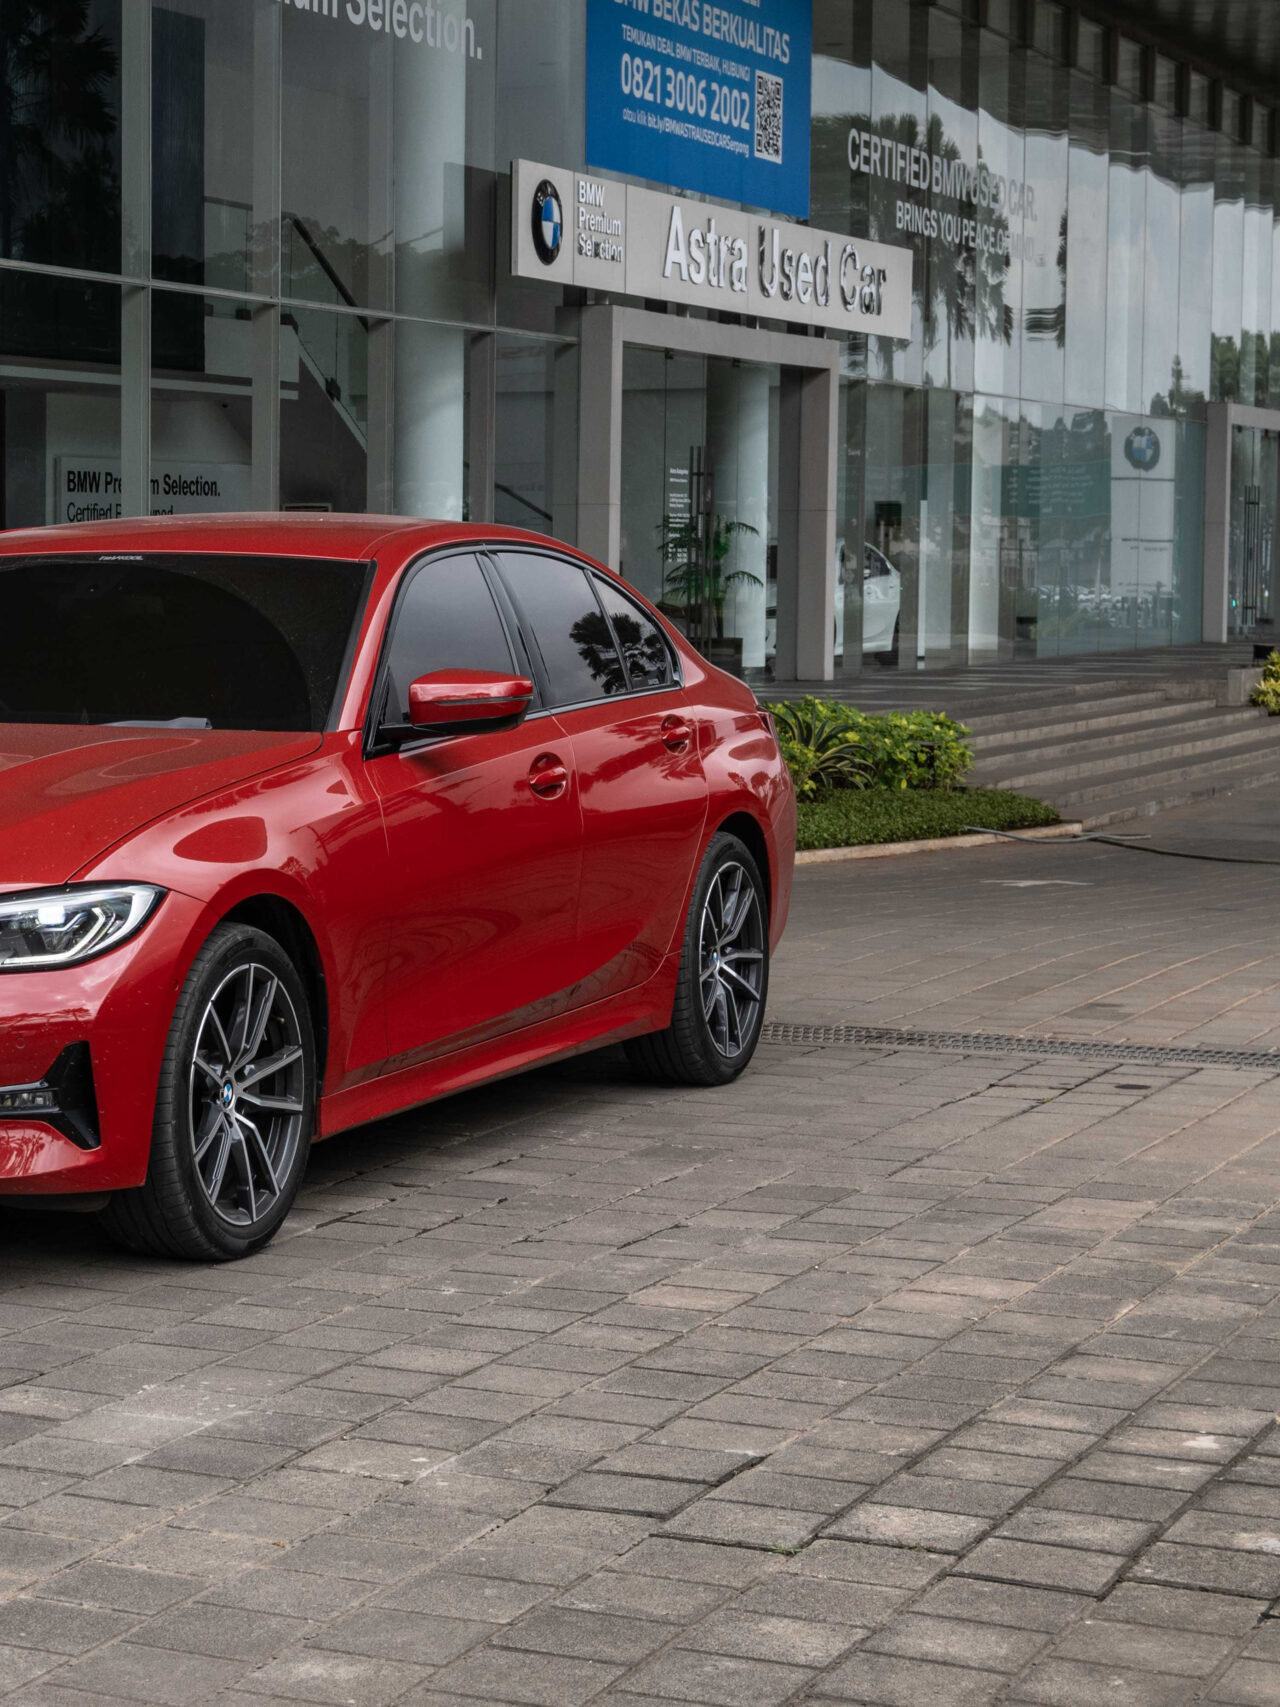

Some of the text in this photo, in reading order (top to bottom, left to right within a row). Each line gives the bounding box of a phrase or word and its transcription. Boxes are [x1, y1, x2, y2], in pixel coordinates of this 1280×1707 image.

[621, 24, 657, 51] TEMUKAN
[657, 37, 675, 57] DEAL
[676, 43, 693, 62] BMW
[722, 61, 751, 81] HUBUNGI
[653, 0, 791, 64] BEKAS BERKUALITAS
[621, 53, 750, 130] 0821 3006 2002
[578, 180, 606, 207] BMW
[848, 128, 930, 191] CERTIFIED
[931, 154, 968, 202] BMW
[970, 165, 1006, 211] USED
[578, 207, 621, 236] Premium
[896, 200, 937, 238] BRINGS
[938, 210, 960, 245] YOU
[962, 217, 996, 252] PEACE
[578, 233, 623, 263] Selection
[663, 205, 887, 316] Astra Used Car
[67, 470, 101, 493] BMW
[163, 473, 221, 497] Selection.
[67, 502, 112, 522] Certified
